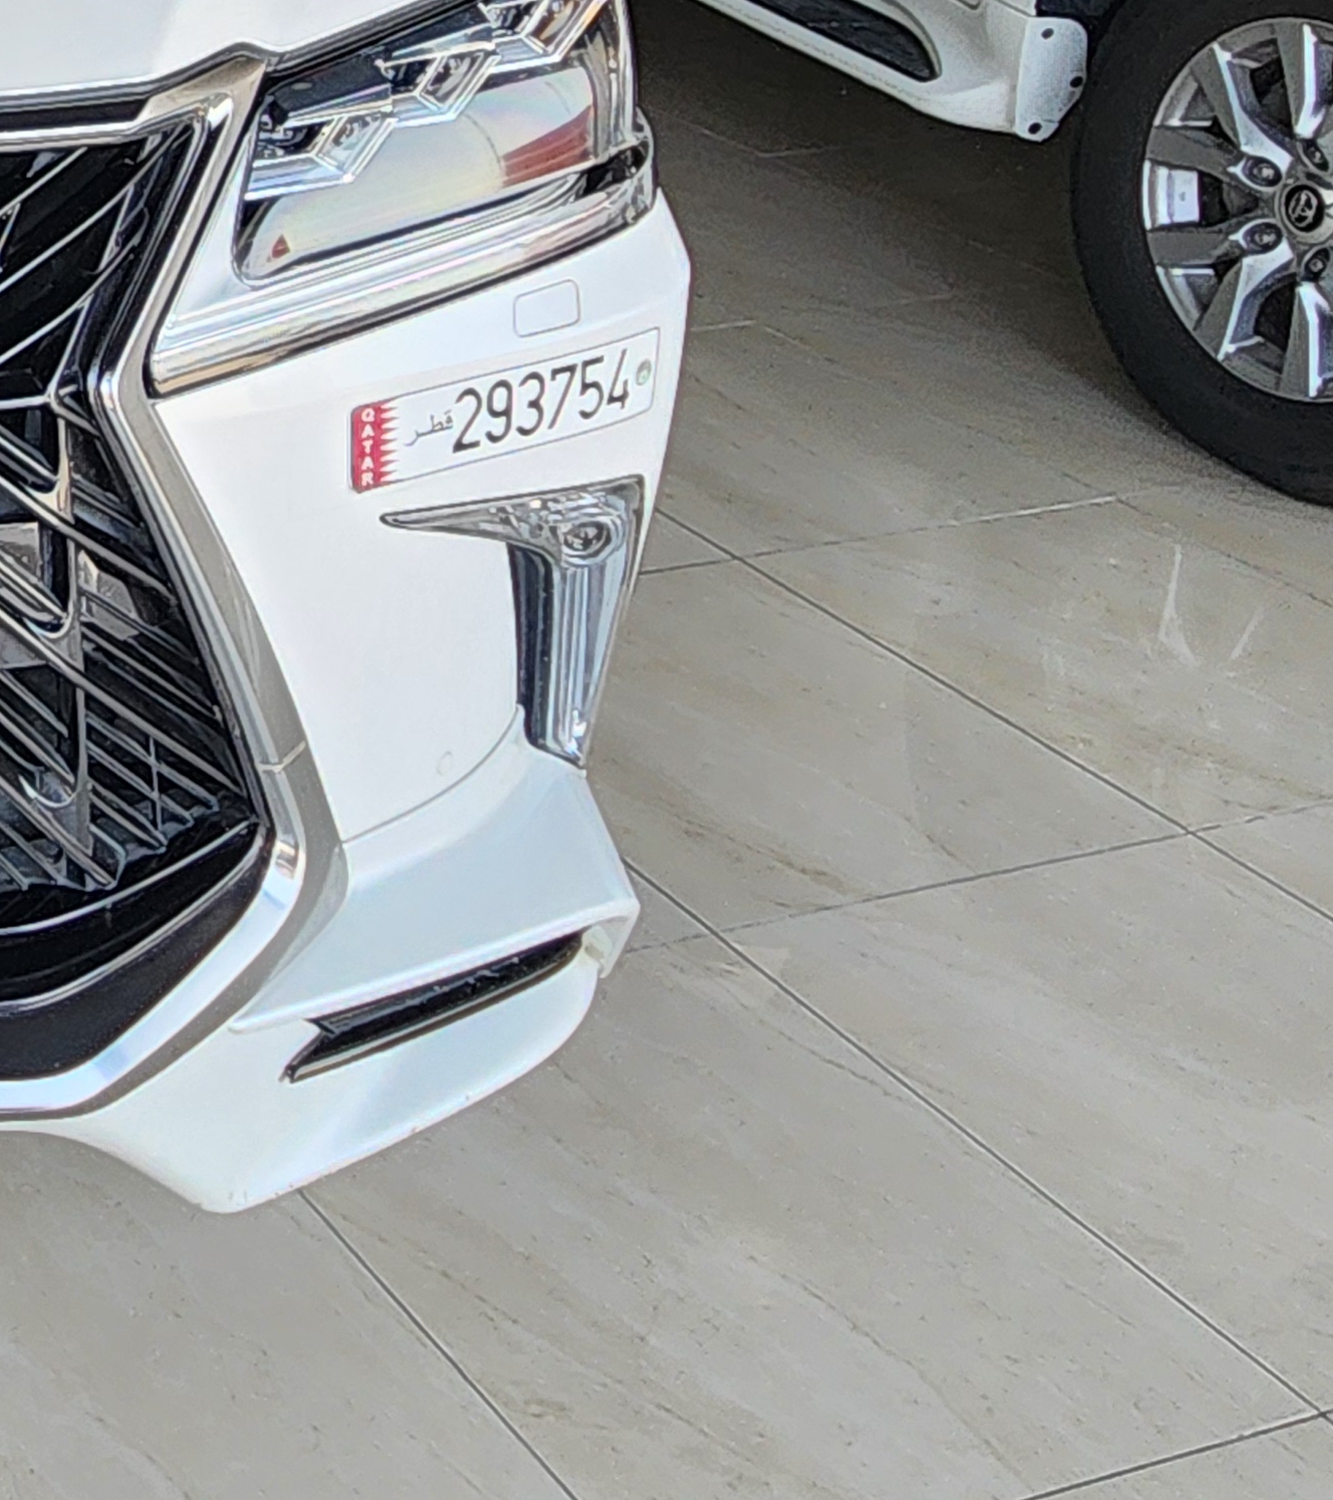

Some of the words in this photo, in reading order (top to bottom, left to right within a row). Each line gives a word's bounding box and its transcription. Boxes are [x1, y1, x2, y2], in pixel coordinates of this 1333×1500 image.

[360, 407, 376, 488] QATAR
[405, 411, 453, 447] قطر
[452, 348, 630, 455] 293754
